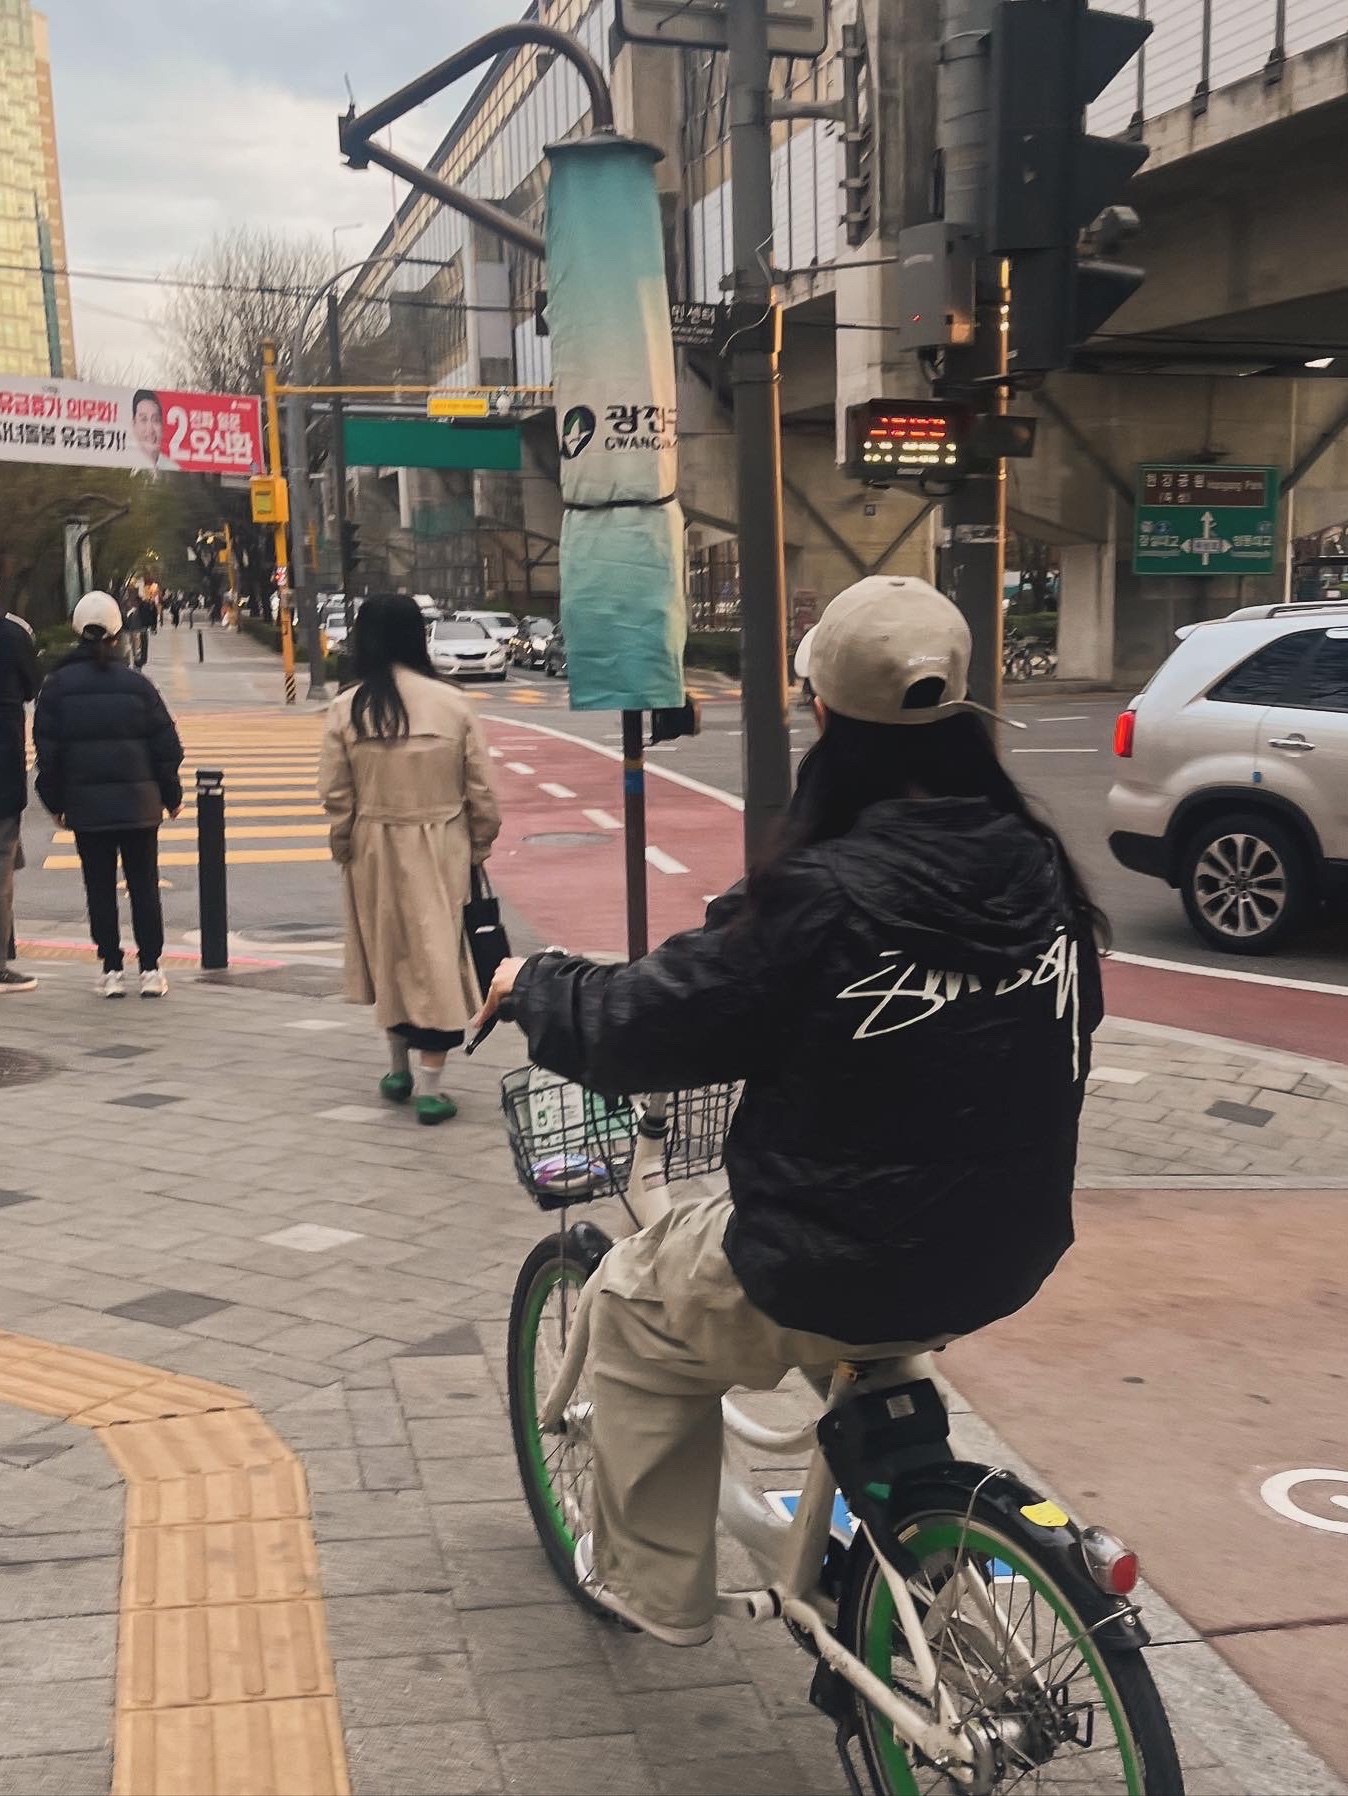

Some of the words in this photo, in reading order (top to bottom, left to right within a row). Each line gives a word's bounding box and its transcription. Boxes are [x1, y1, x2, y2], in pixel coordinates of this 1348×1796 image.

[61, 426, 126, 451] 유급휴가!
[167, 405, 191, 462] 2
[189, 430, 253, 464] 오신환
